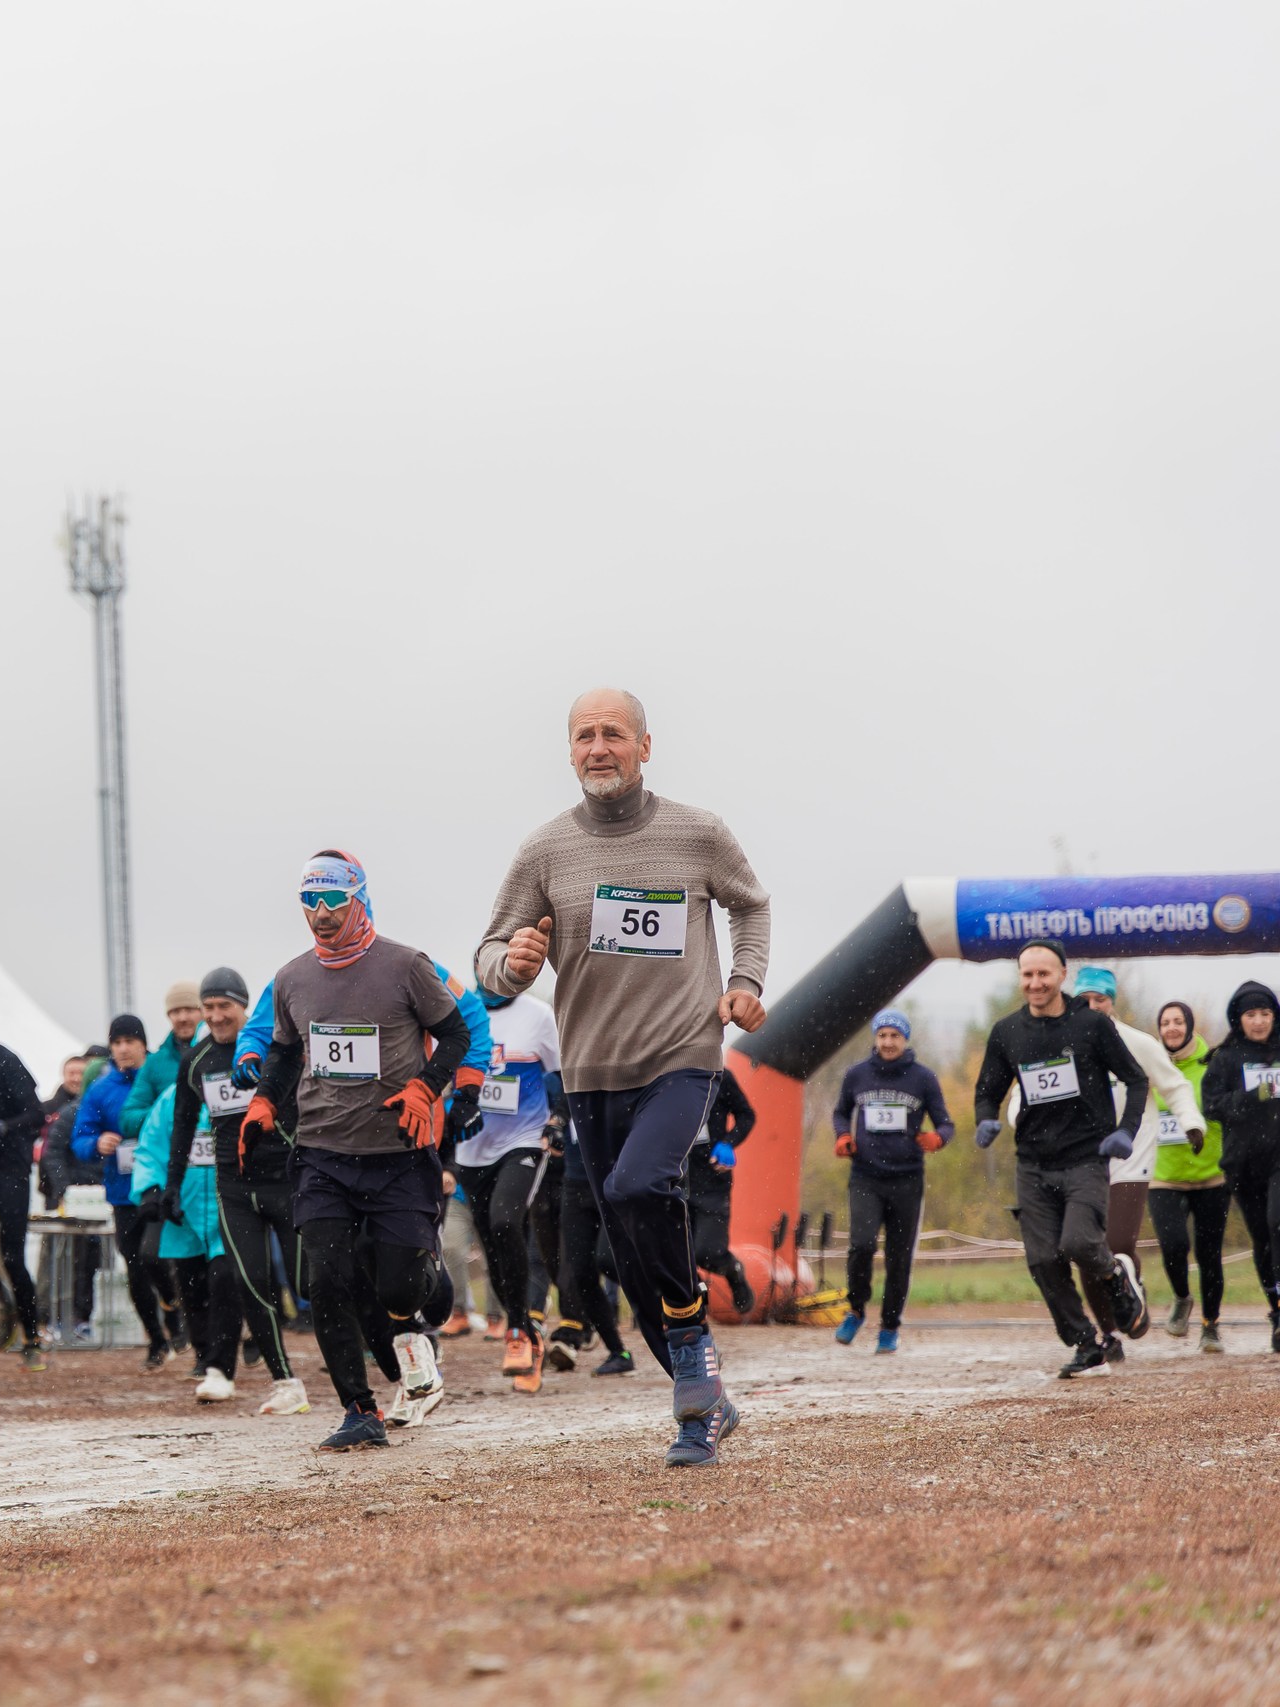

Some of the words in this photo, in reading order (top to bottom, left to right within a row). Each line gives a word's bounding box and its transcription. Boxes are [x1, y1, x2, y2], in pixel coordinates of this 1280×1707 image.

[610, 889, 644, 899] КРОСС
[645, 892, 683, 901] ДУАТЛОН
[620, 908, 660, 937] 56
[985, 908, 1093, 940] ТАТНЕФТЬ
[1094, 902, 1210, 936] ПРОФСОЮЗ
[328, 1041, 353, 1063] 81
[1038, 1071, 1060, 1090] 52
[220, 1084, 241, 1101] 62
[482, 1085, 502, 1101] 60
